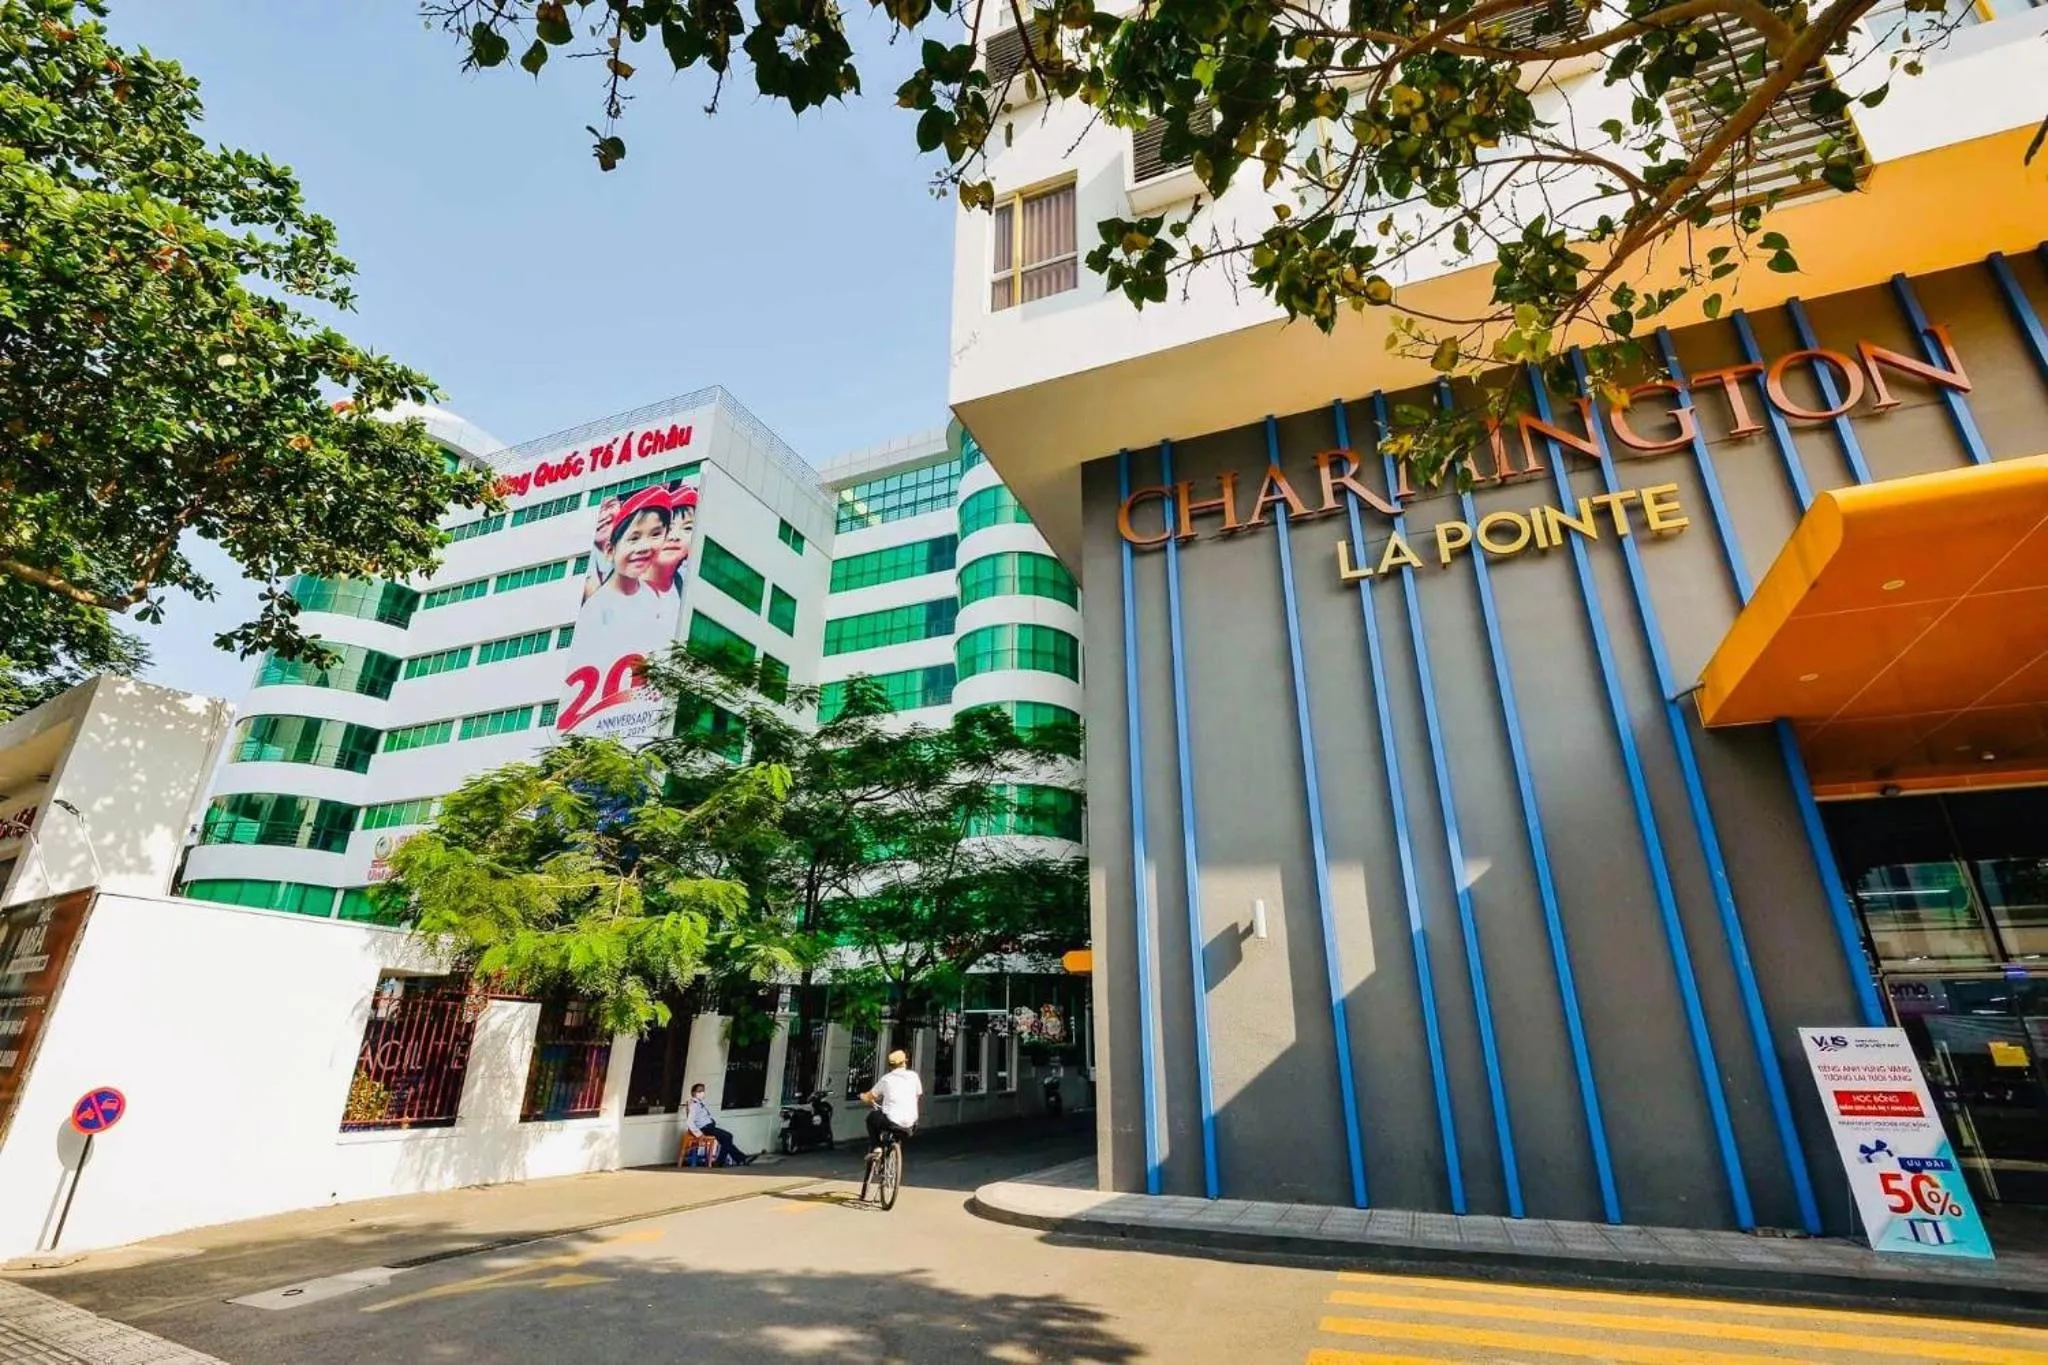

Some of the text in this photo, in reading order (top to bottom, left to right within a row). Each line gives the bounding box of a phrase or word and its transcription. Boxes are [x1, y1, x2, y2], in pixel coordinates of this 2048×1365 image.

[533, 450, 585, 488] Quốc
[617, 430, 634, 465] Á
[638, 423, 694, 458] Châu
[1337, 482, 1691, 581] LA POINTE
[557, 653, 649, 735] 20
[596, 710, 653, 730] ANNIVERSARY
[1879, 1172, 1963, 1217] 50%
